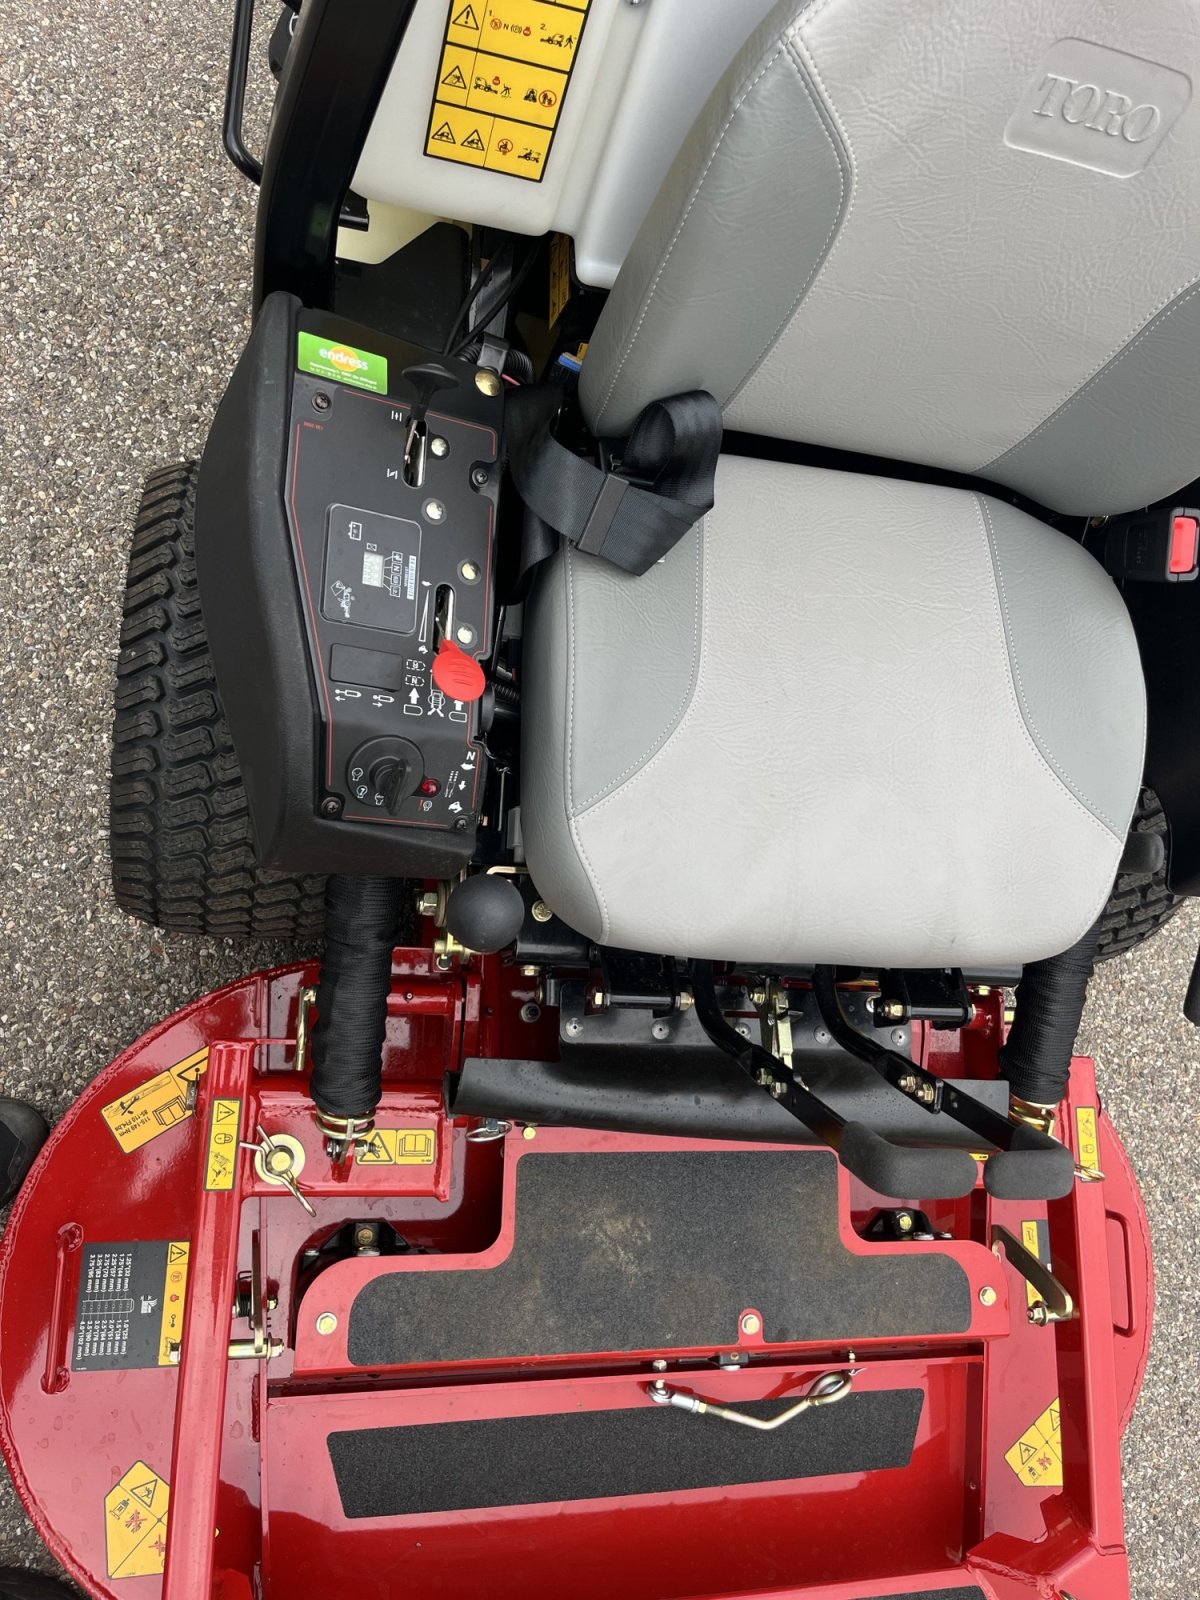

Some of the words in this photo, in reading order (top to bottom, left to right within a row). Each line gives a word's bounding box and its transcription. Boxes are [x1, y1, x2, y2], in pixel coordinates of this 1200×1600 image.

[1032, 73, 1160, 143] TORO
[319, 348, 368, 370] endress
[466, 751, 476, 760] N
